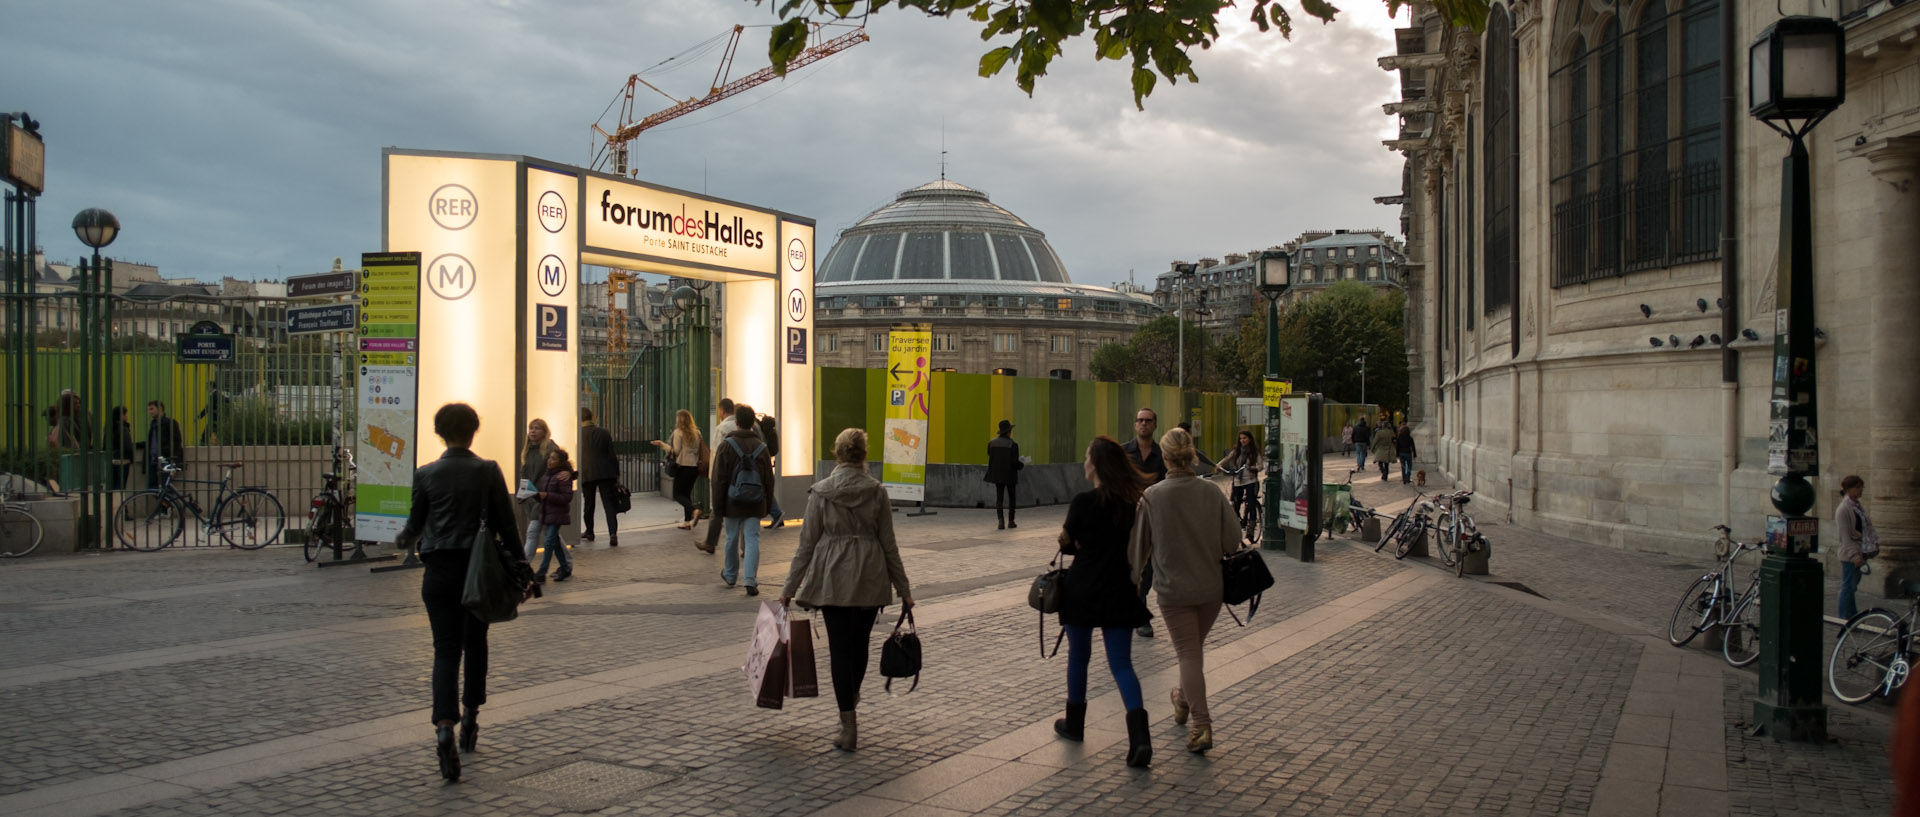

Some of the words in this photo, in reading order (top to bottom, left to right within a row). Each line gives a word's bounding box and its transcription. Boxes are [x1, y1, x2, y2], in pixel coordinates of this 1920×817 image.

[435, 198, 472, 216] RER
[541, 204, 563, 219] RER
[643, 235, 666, 248] Porte
[668, 238, 689, 251] SAINT
[692, 242, 728, 258] EUSTACHE
[790, 249, 804, 260] RER
[439, 264, 464, 289] M
[544, 265, 560, 286] M
[792, 297, 802, 314] M
[541, 306, 558, 336] P
[790, 329, 801, 352] P
[891, 336, 929, 344] Traversée
[904, 345, 927, 354] jardin
[893, 390, 901, 402] P
